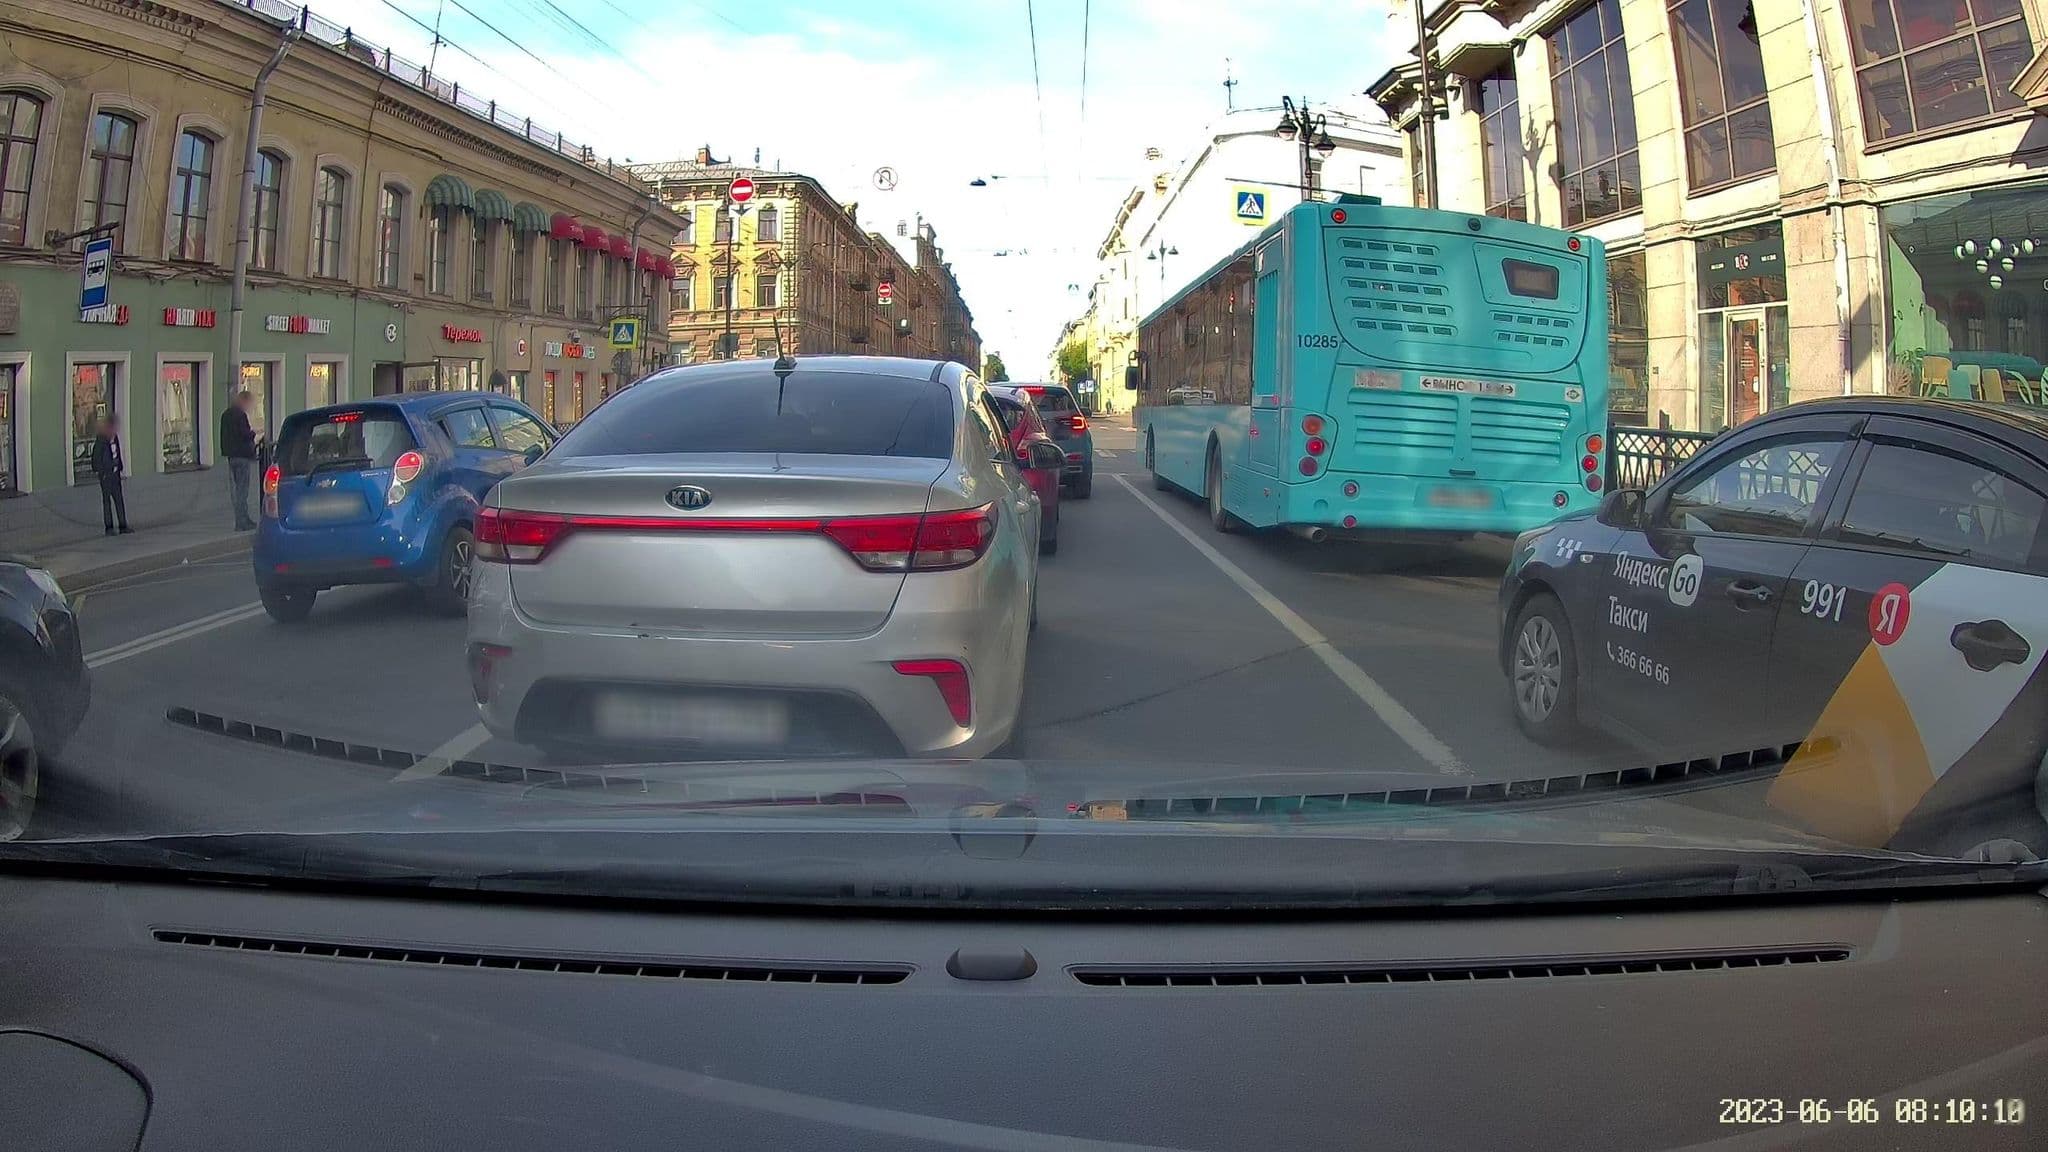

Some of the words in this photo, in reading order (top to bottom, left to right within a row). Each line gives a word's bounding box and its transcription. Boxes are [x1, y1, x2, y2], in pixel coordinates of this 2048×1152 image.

[265, 314, 290, 332] STREET
[1297, 334, 1339, 349] 10285
[670, 490, 703, 506] KIA
[1613, 550, 1669, 590] Яндекс
[1673, 563, 1697, 596] Go
[1609, 596, 1649, 633] Такси
[1801, 579, 1847, 622] 991
[1876, 594, 1901, 635] Я
[1617, 646, 1637, 669] 366
[1639, 655, 1652, 677] 66
[1655, 663, 1670, 685] 66
